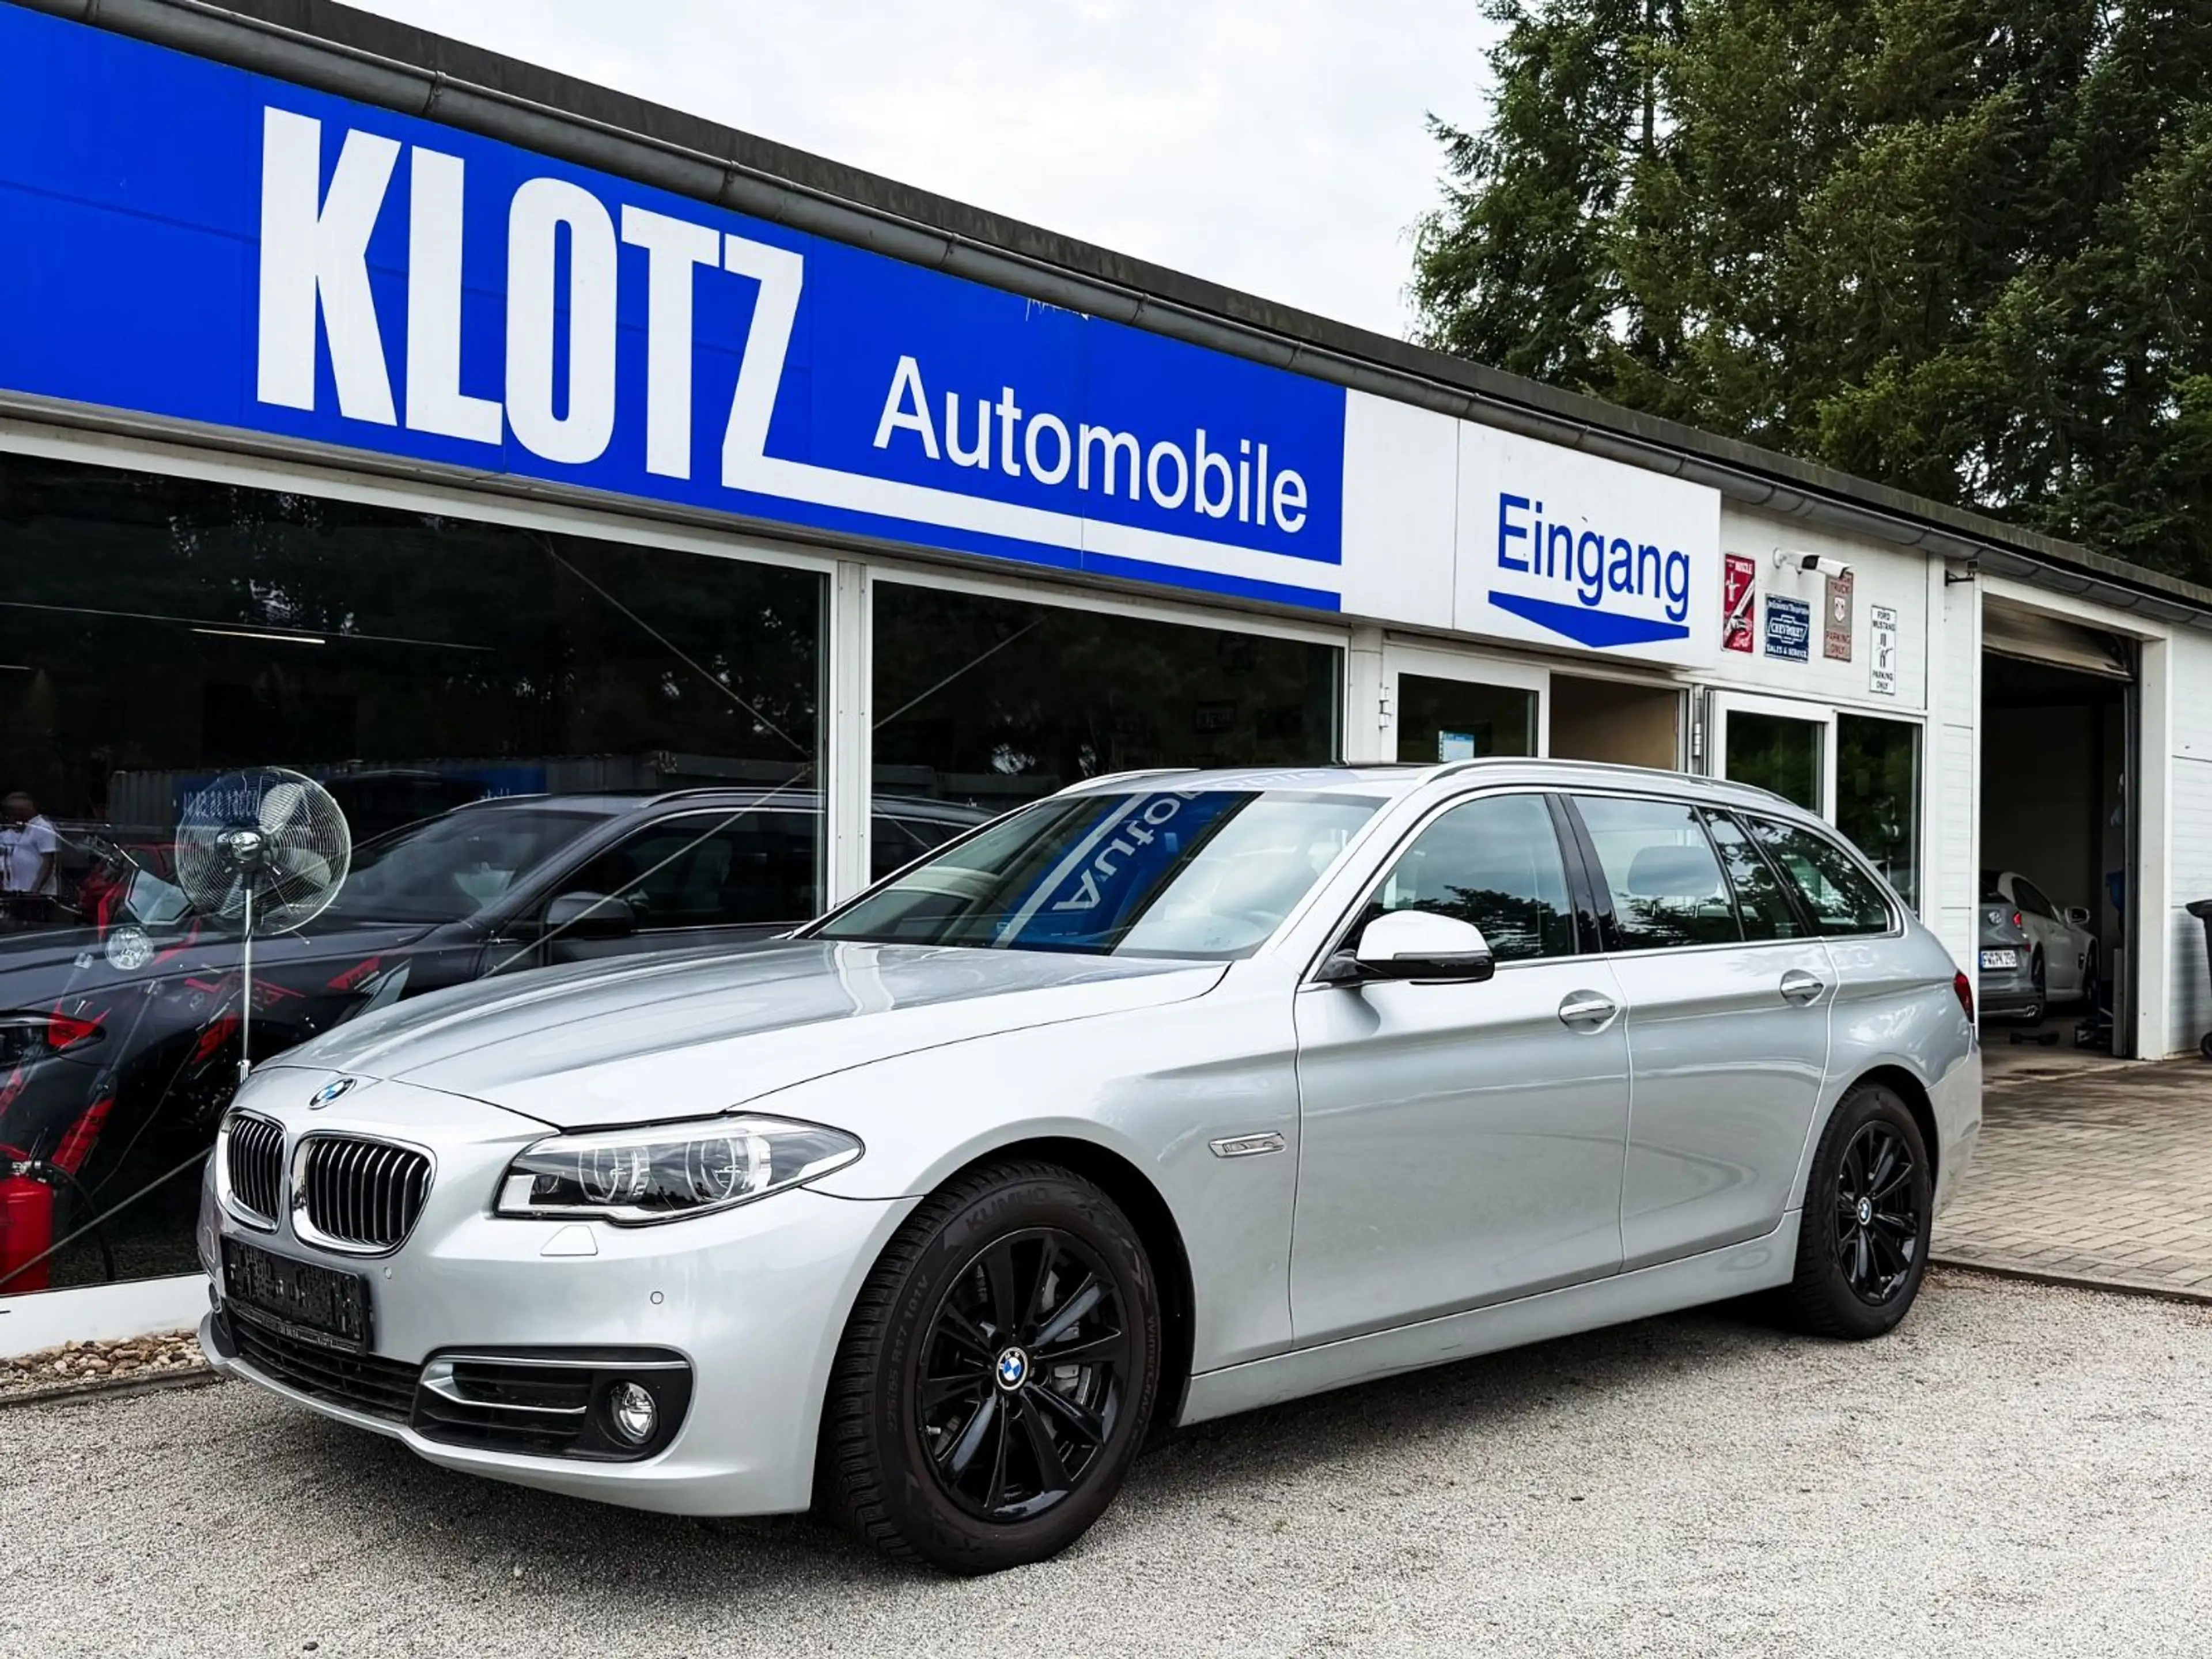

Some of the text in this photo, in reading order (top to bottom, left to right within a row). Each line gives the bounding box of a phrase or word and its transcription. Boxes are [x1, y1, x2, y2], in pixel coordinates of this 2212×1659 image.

[257, 106, 804, 493] KLOTZ
[873, 355, 1308, 533] Automobile
[1498, 493, 1690, 622] Eingang
[965, 1187, 1048, 1232] KUMHO
